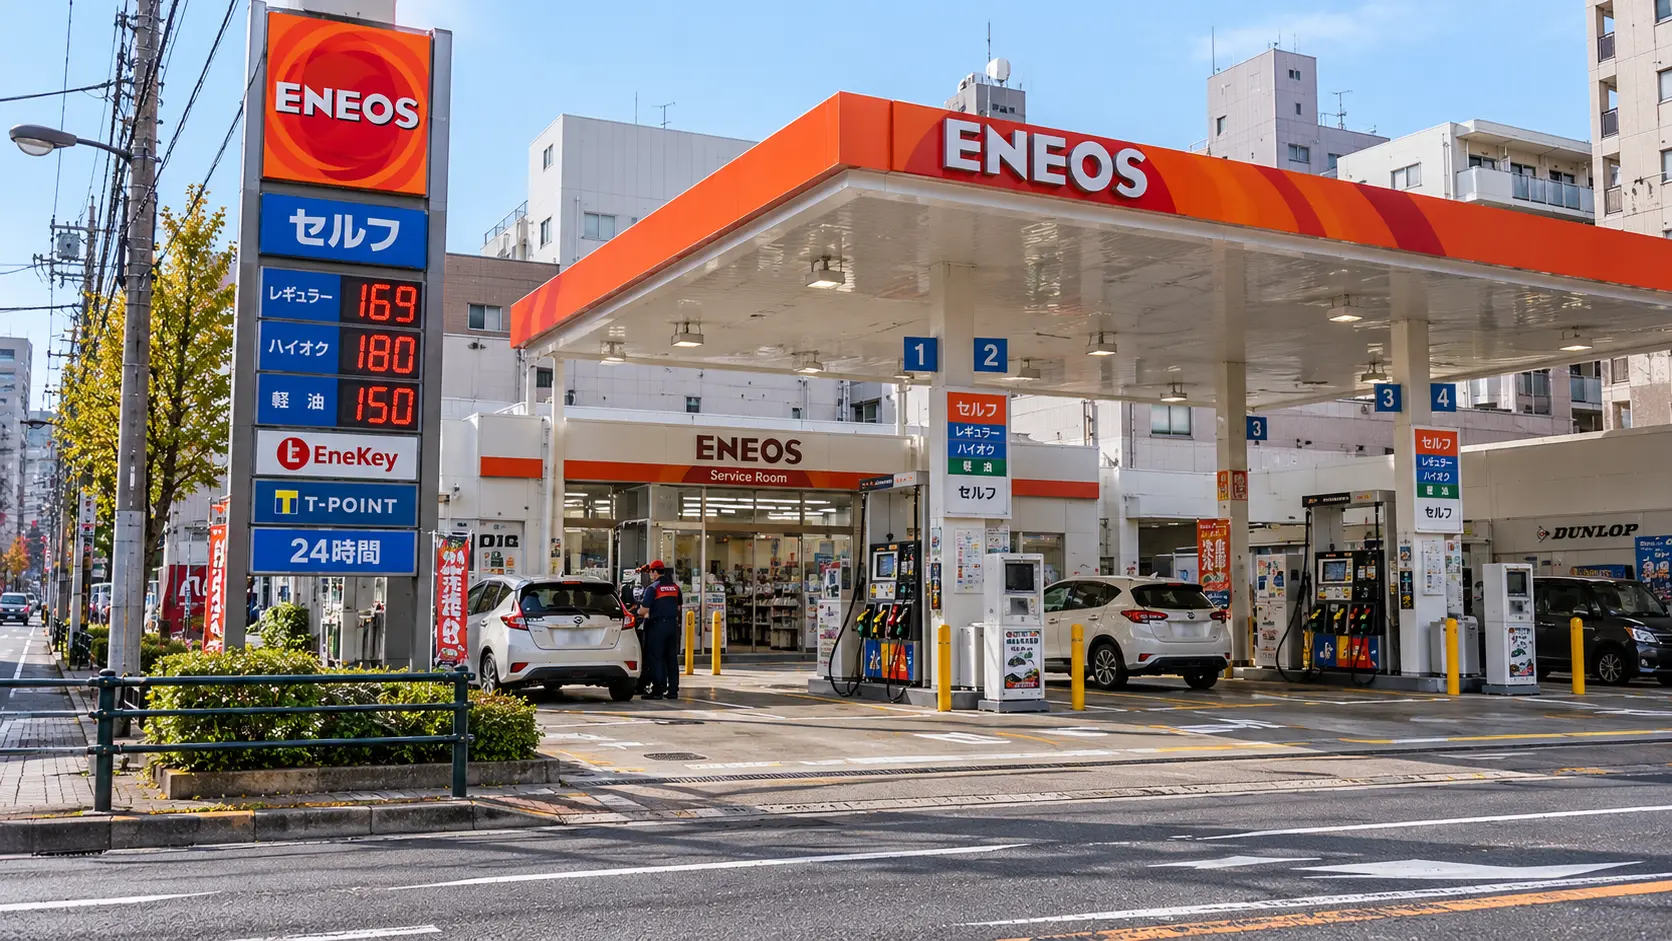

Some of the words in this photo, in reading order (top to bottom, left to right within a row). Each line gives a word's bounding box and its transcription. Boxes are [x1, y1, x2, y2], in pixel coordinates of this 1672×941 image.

[276, 81, 420, 130] ENEOS
[943, 117, 1148, 199] ENEOS
[289, 208, 400, 252] セルフ
[269, 286, 333, 303] レギュラー
[359, 283, 417, 323] 169
[268, 339, 329, 357] ハイオク
[357, 334, 416, 374] 180
[915, 343, 924, 366] 1
[983, 344, 998, 366] 2
[356, 386, 414, 425] 150
[1382, 388, 1394, 408] 3
[1437, 388, 1449, 408] 4
[956, 400, 997, 417] セルフ
[955, 425, 1000, 438] レギュラー
[1252, 420, 1262, 437] 3
[696, 434, 802, 465] ENEOS
[957, 444, 995, 455] ハイオク
[1422, 436, 1451, 450] セルフ
[314, 445, 399, 472] EneKey
[710, 469, 752, 482] Service
[755, 471, 787, 483] Room
[959, 486, 996, 500] セルフ
[304, 496, 398, 514] T-POINT
[1425, 506, 1452, 519] セルフ
[1551, 524, 1639, 539] DUNLOP
[290, 538, 381, 565] 24時間
